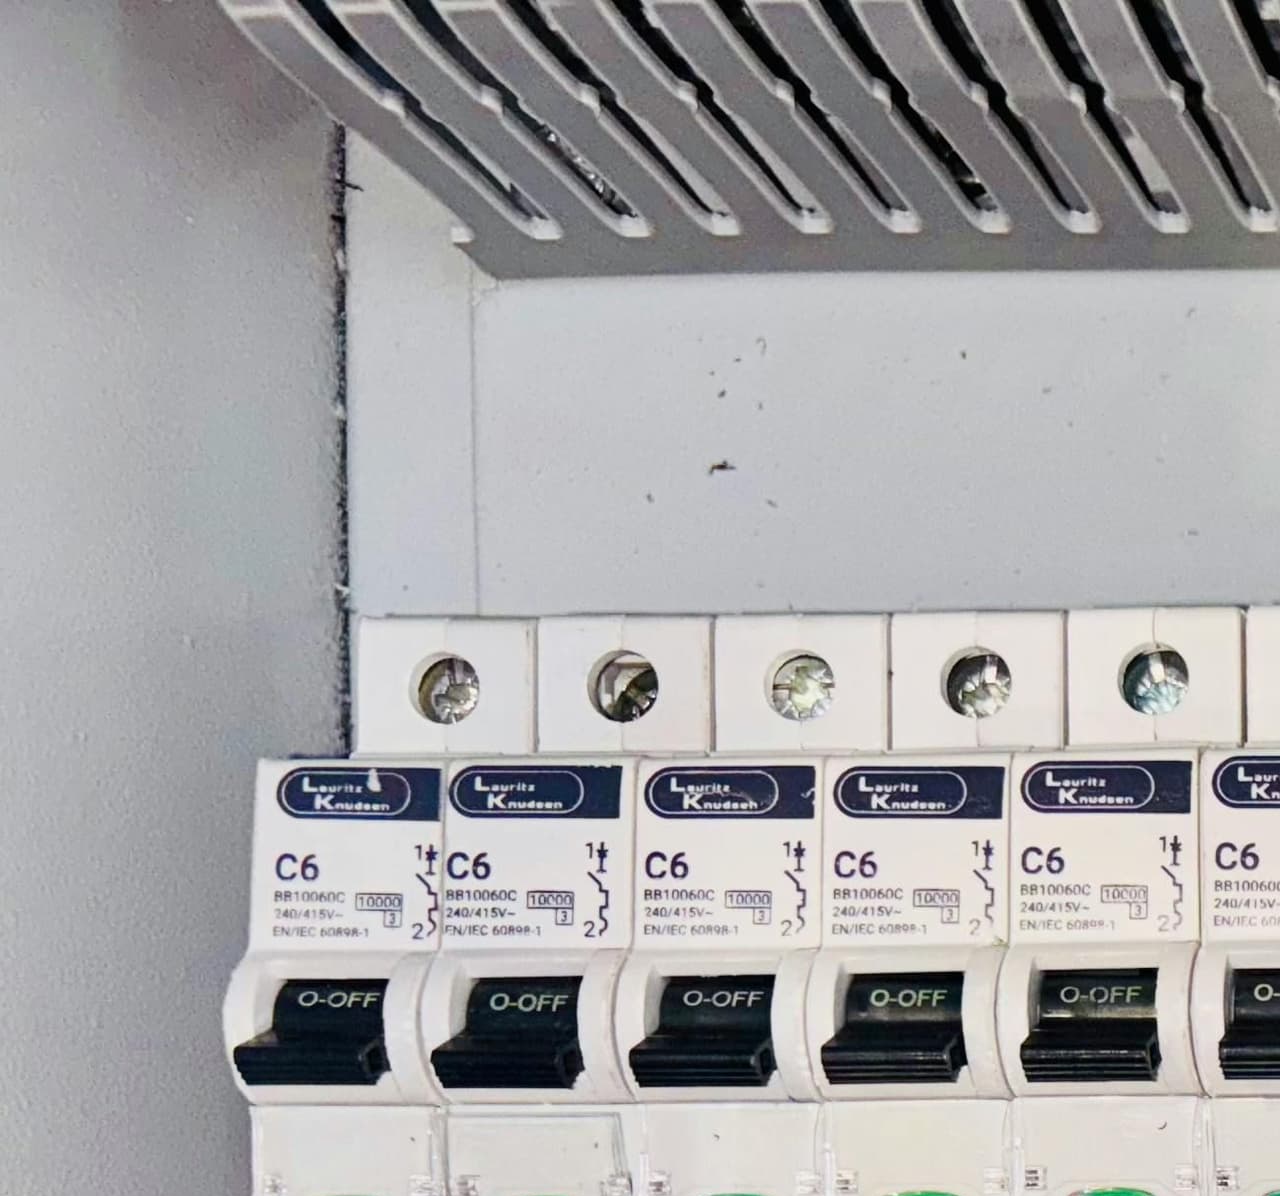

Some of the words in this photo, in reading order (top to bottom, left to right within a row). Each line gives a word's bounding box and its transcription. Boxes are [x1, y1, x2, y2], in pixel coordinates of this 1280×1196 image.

[314, 794, 389, 810] Knudsen
[871, 794, 946, 809] Knudsen
[276, 853, 319, 881] C6
[447, 852, 490, 880] C6
[645, 851, 688, 879] C6
[834, 851, 877, 878] C6
[1022, 847, 1064, 874] C6
[1215, 842, 1259, 870] C6
